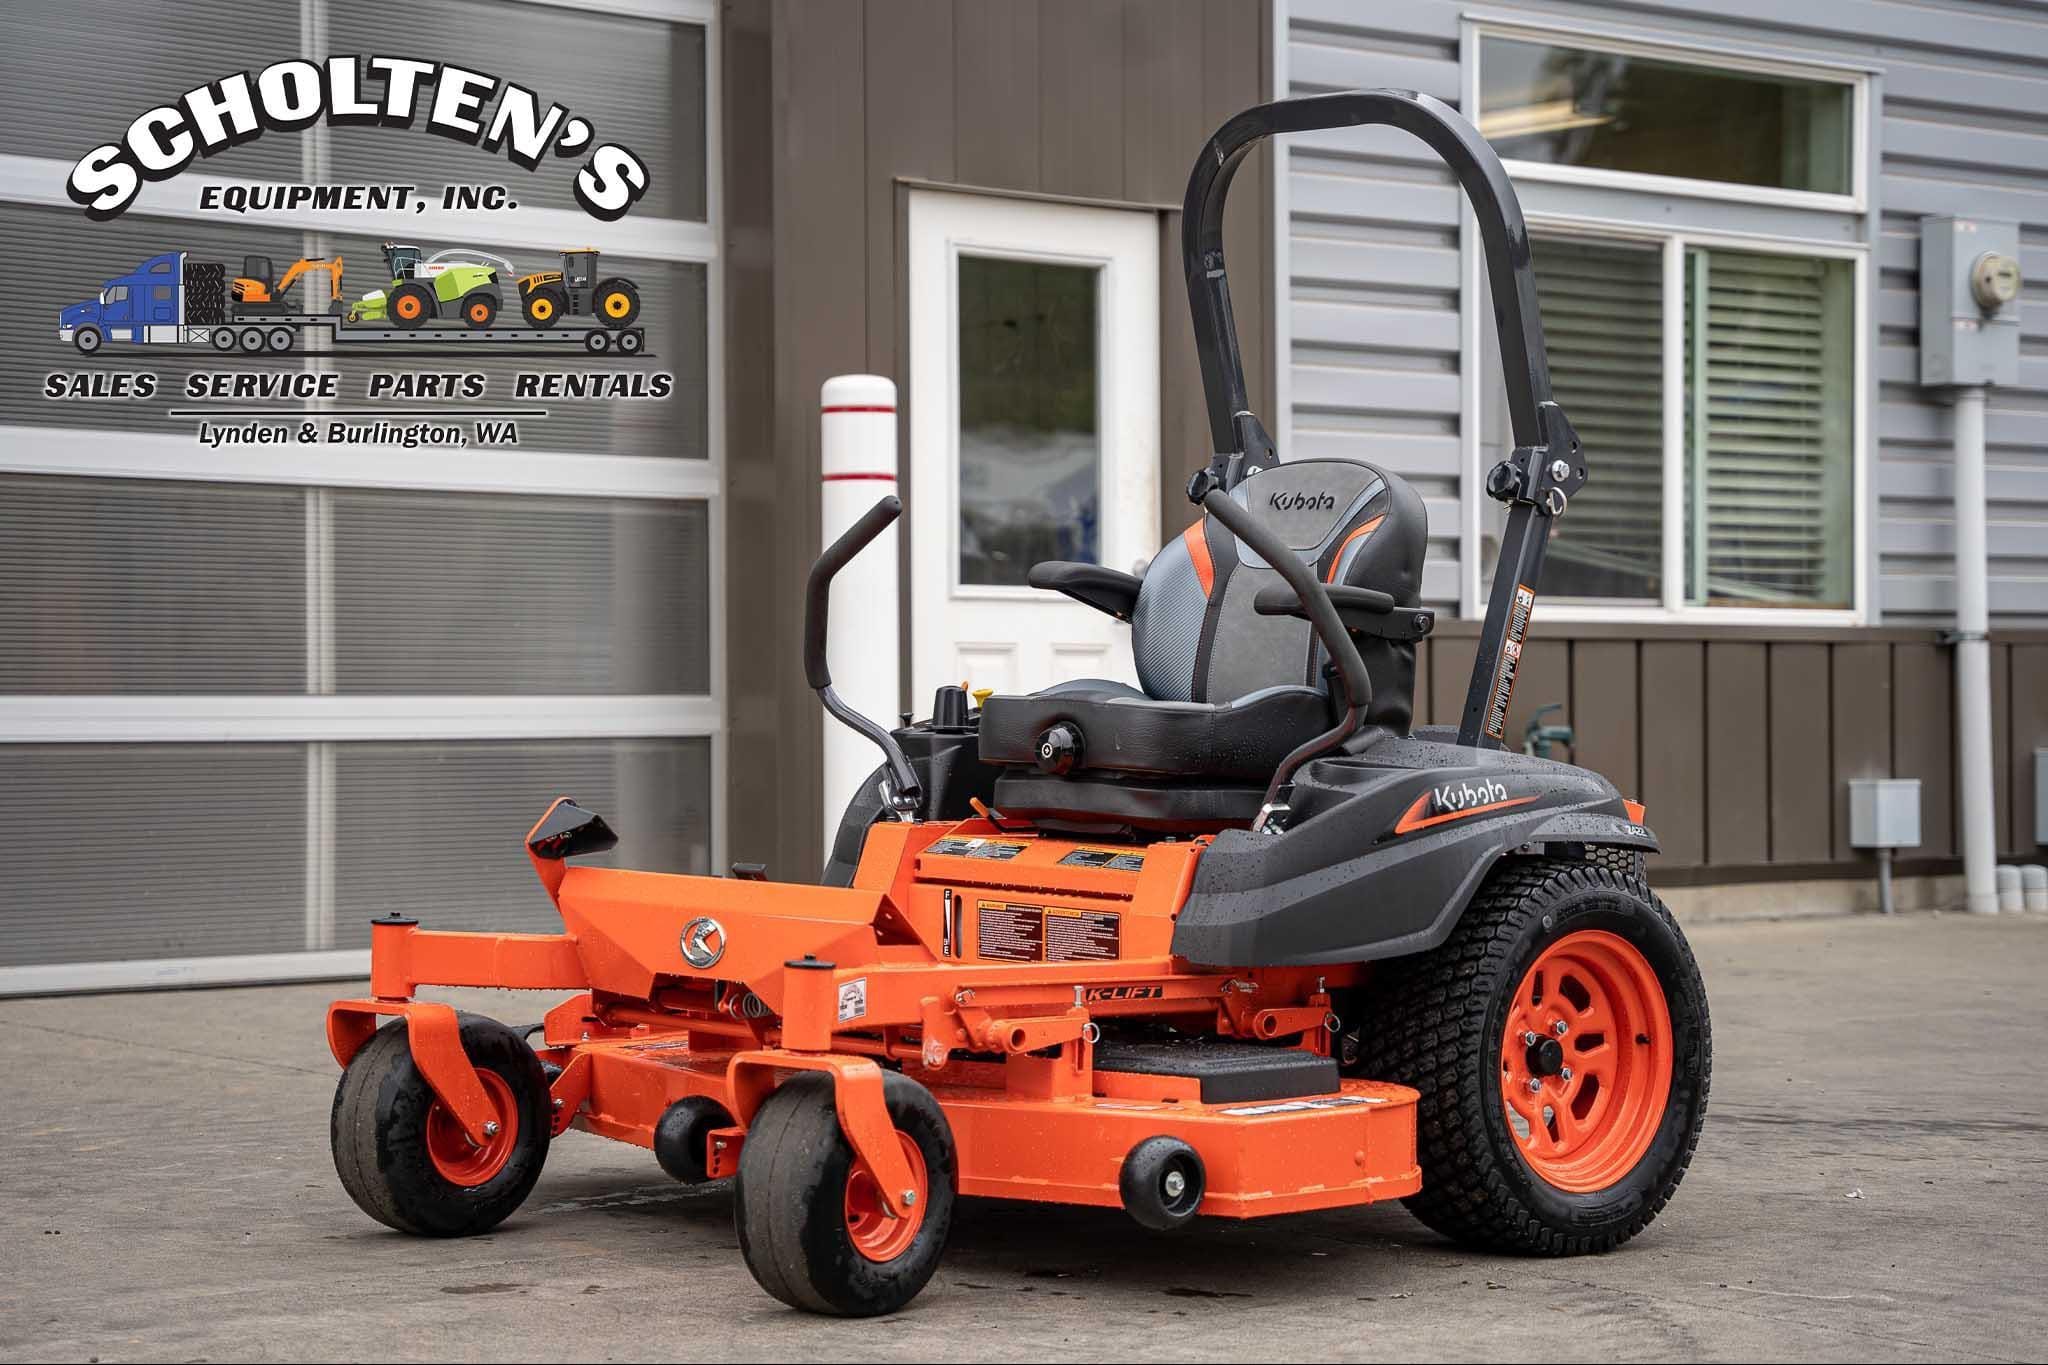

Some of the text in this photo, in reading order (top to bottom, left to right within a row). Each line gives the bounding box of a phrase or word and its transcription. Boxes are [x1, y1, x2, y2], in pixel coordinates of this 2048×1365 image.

[1269, 491, 1335, 510] Kubota
[1434, 778, 1508, 810] Kubota
[1087, 986, 1160, 1000] K-LIFT
